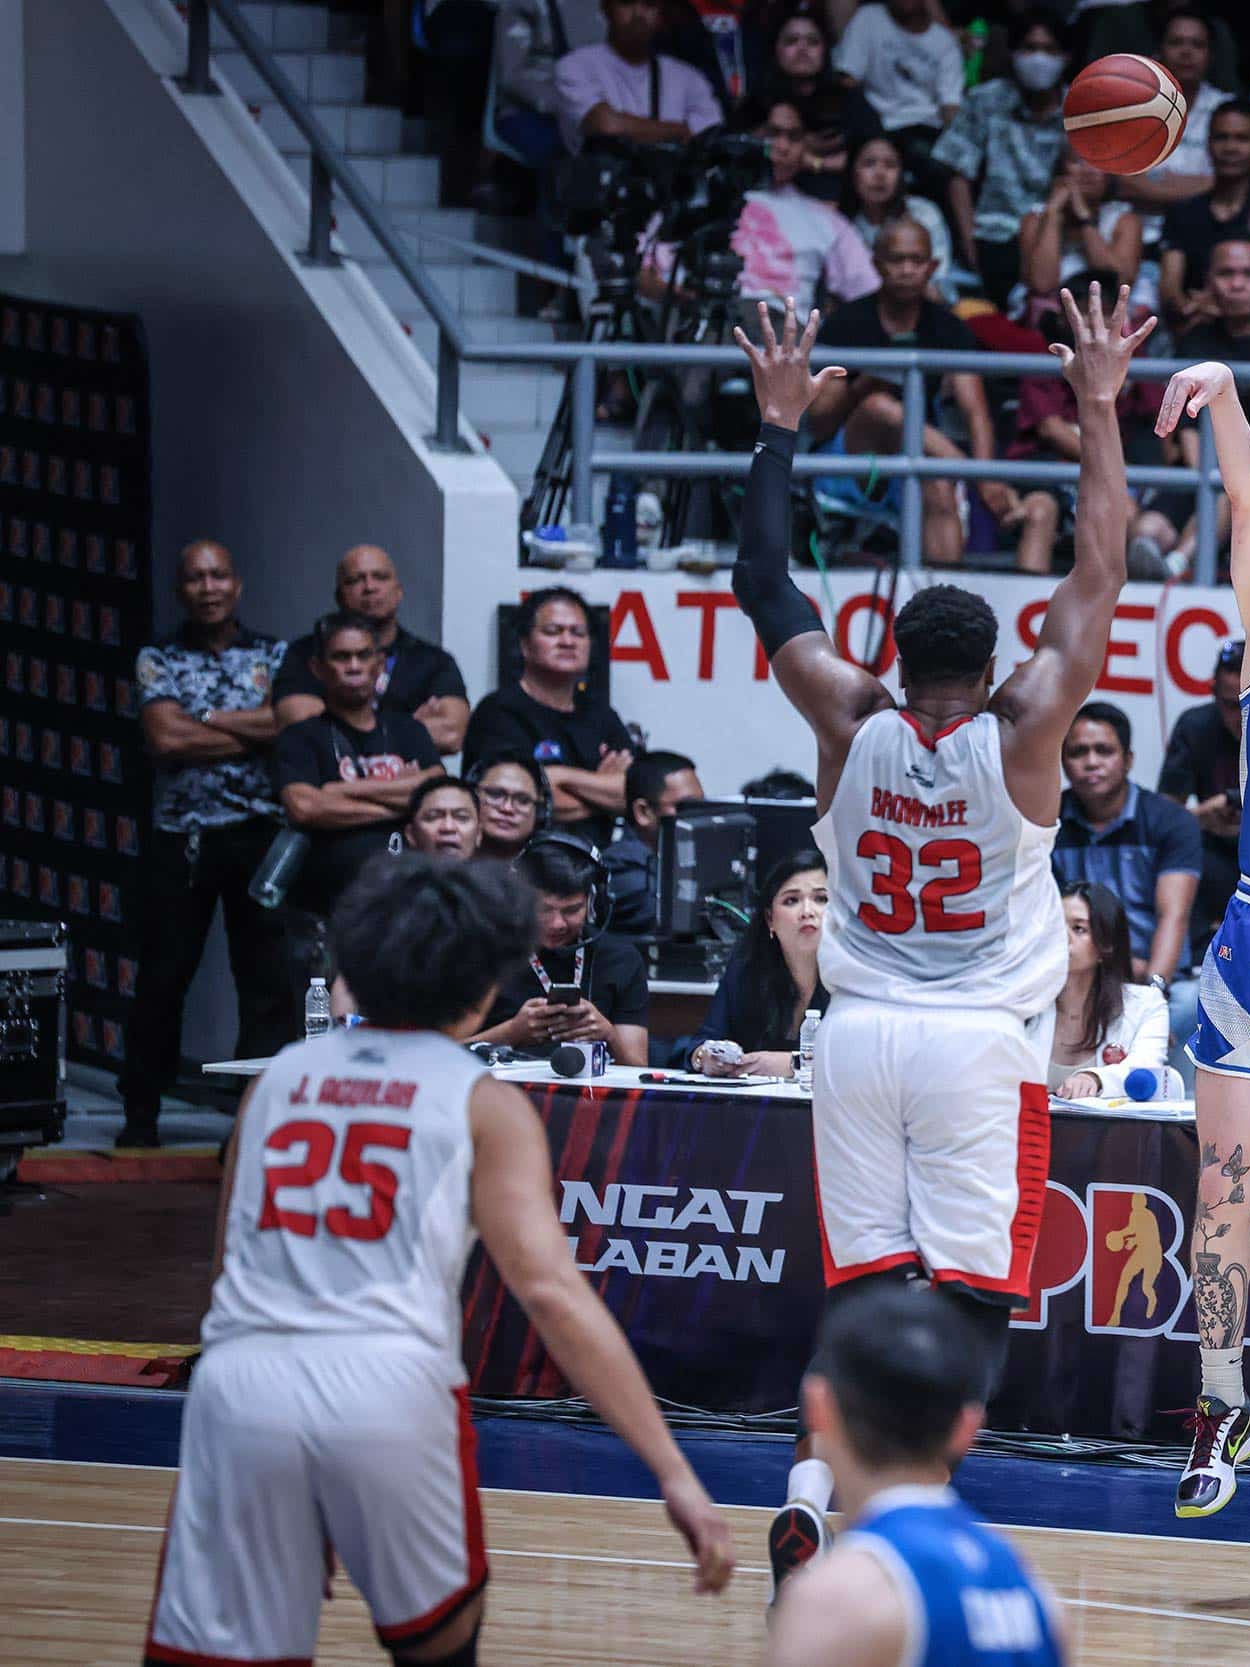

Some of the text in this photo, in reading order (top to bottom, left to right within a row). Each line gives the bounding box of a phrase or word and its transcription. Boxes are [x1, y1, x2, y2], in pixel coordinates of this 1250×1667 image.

[871, 786, 968, 829] BROWNLEE
[857, 830, 986, 935] 32
[258, 1120, 413, 1241] 25
